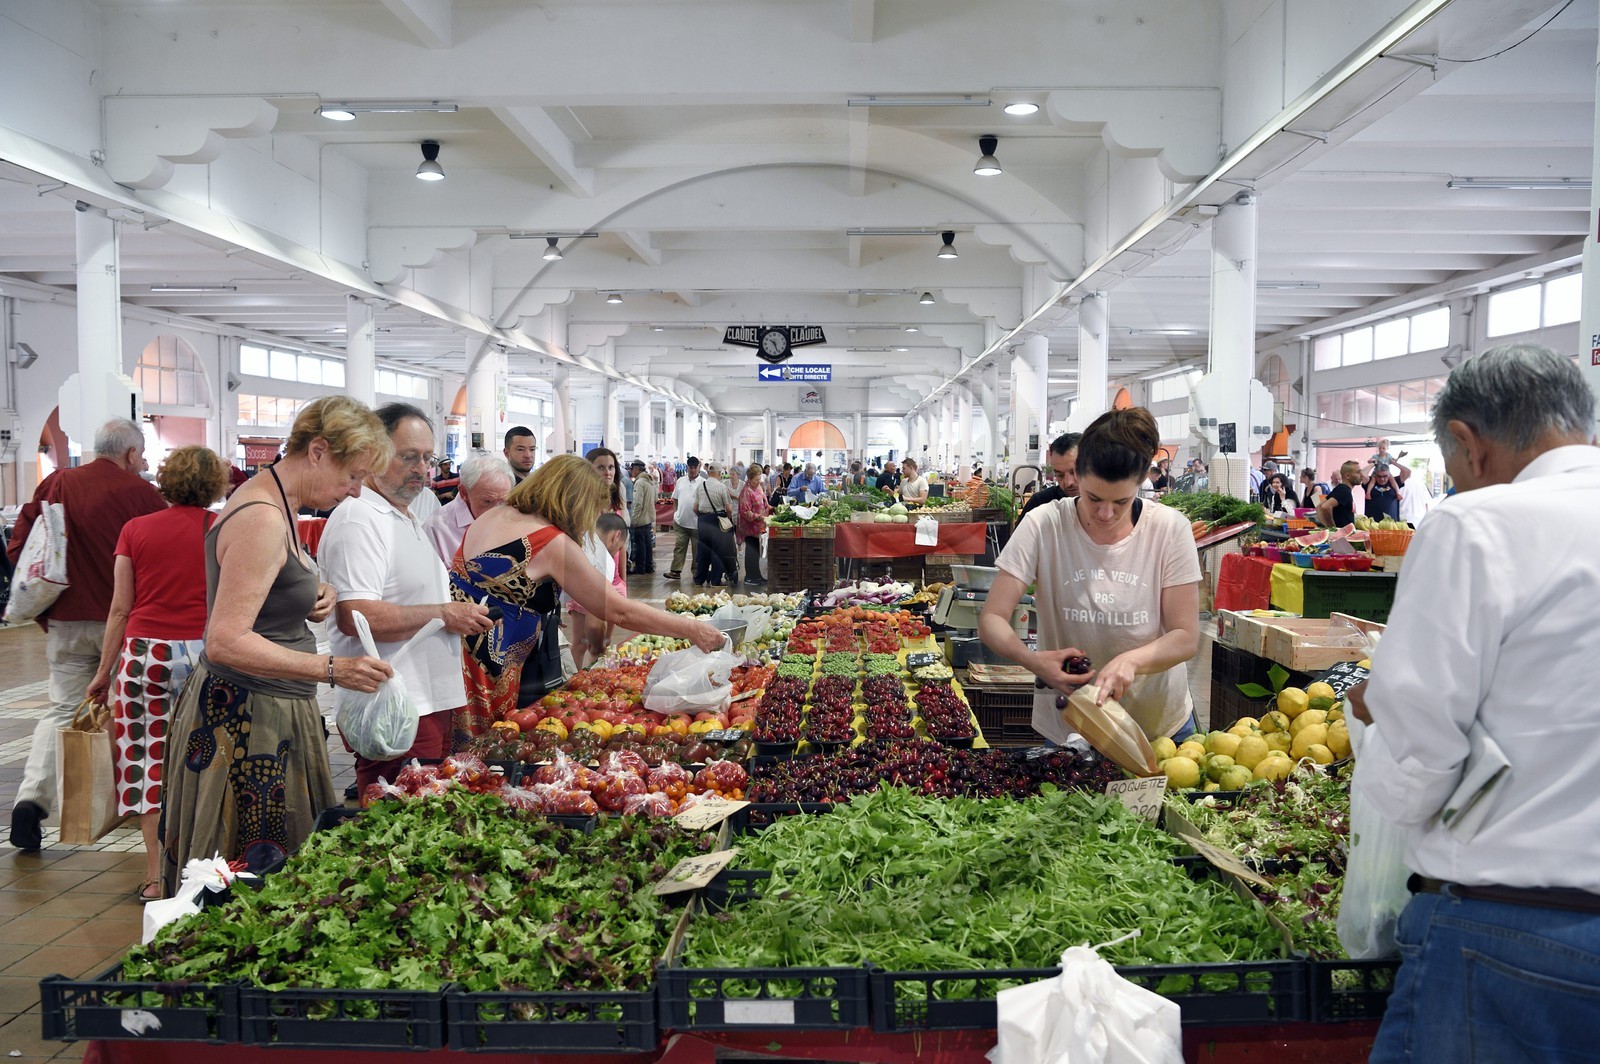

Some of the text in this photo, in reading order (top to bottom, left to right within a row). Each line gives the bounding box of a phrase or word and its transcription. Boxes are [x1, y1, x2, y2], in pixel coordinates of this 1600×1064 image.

[727, 328, 759, 342] CLAUDEL
[790, 327, 823, 342] CLAUDEL
[1073, 568, 1139, 586] JE NE VEUX
[1094, 592, 1115, 604] PAS
[1063, 608, 1149, 625] TRAVAILLER
[1110, 778, 1166, 794] ROQUETTE
